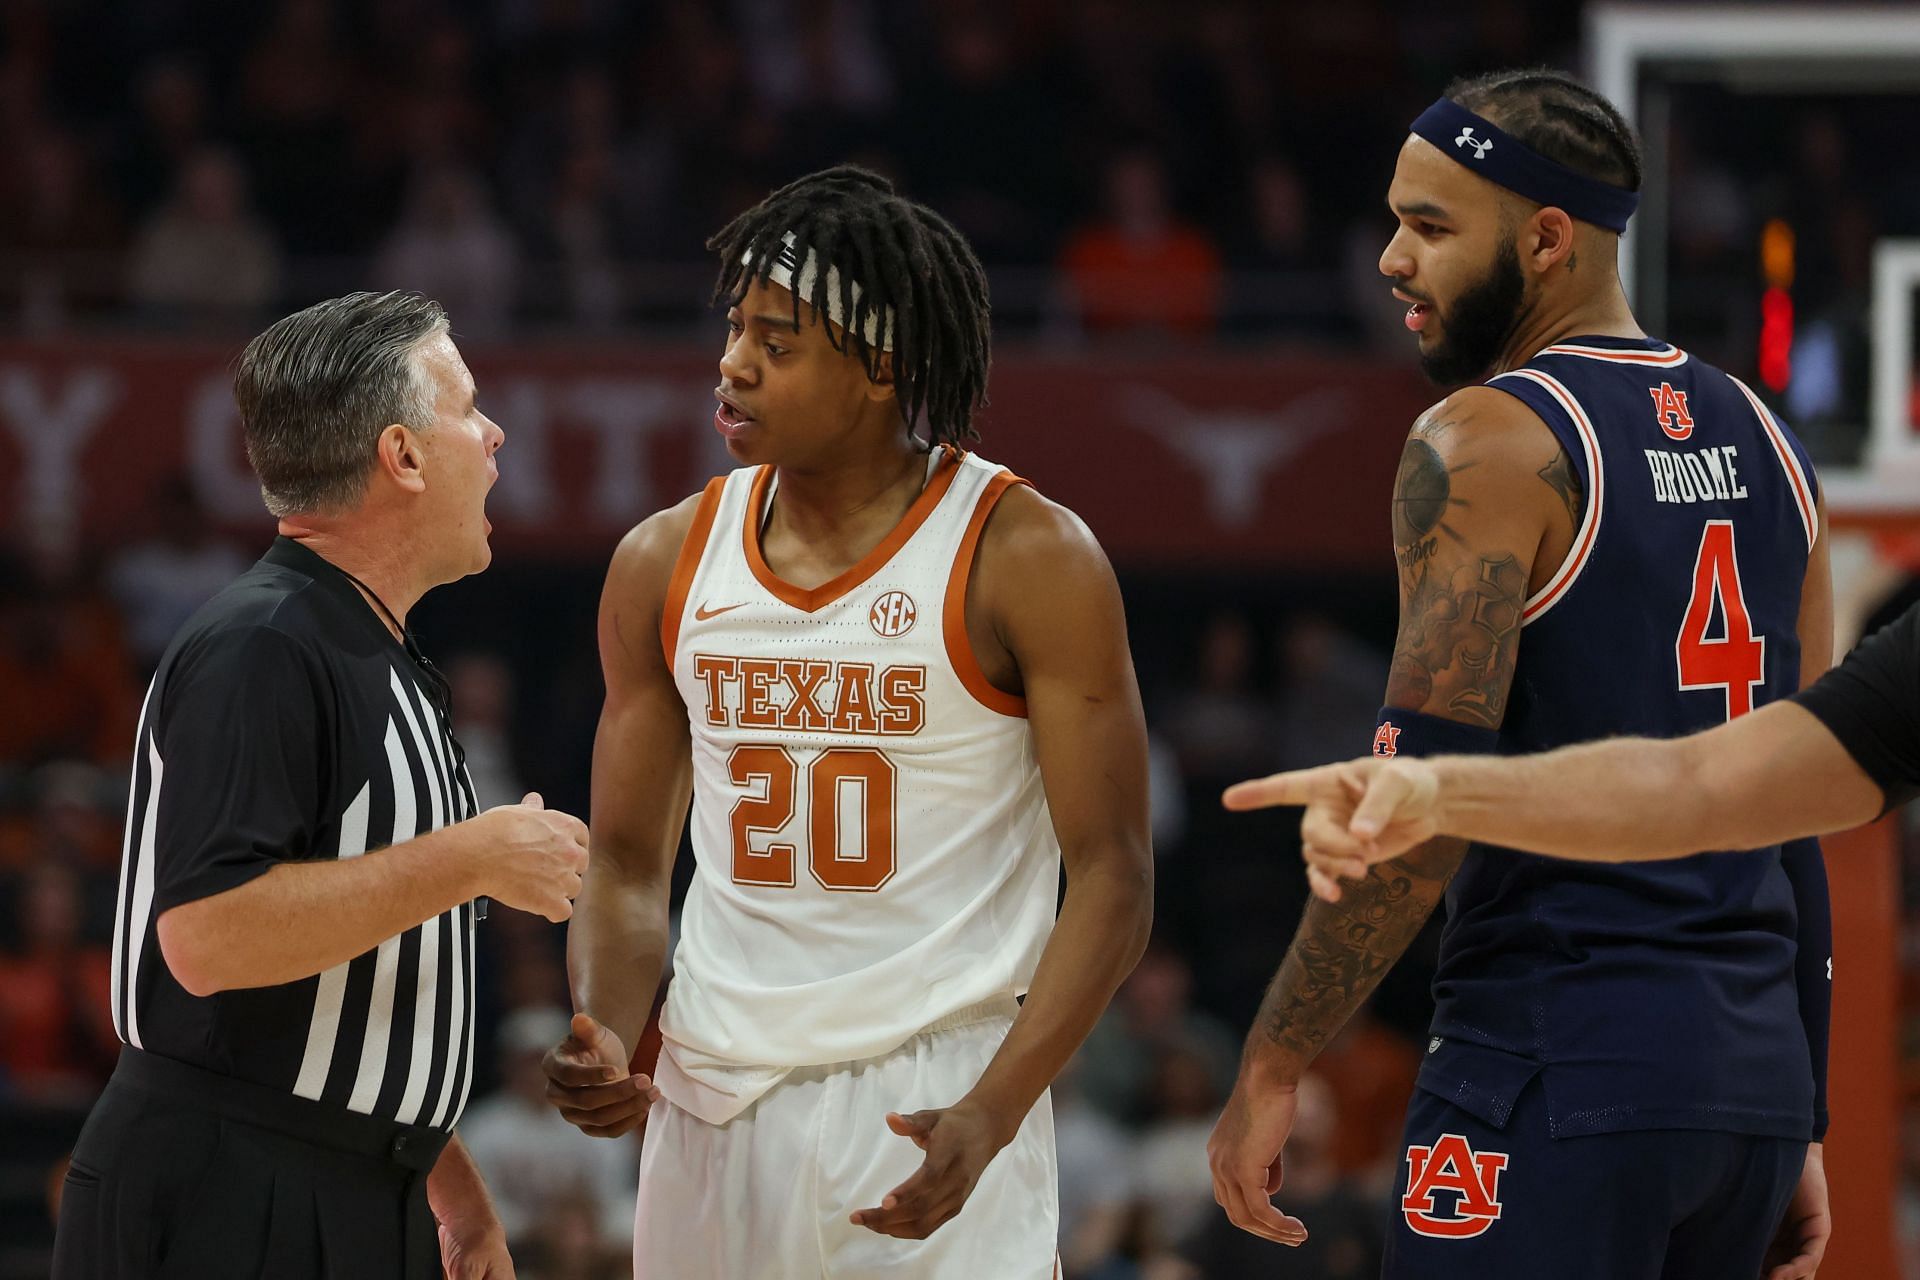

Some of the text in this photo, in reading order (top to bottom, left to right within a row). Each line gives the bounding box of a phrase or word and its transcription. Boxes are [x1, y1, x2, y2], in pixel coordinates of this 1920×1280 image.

[1644, 445, 1748, 503] BROOME
[870, 591, 916, 636] SEC
[1676, 519, 1765, 723] 4
[694, 654, 926, 736] TEXAS
[726, 744, 898, 892] 20
